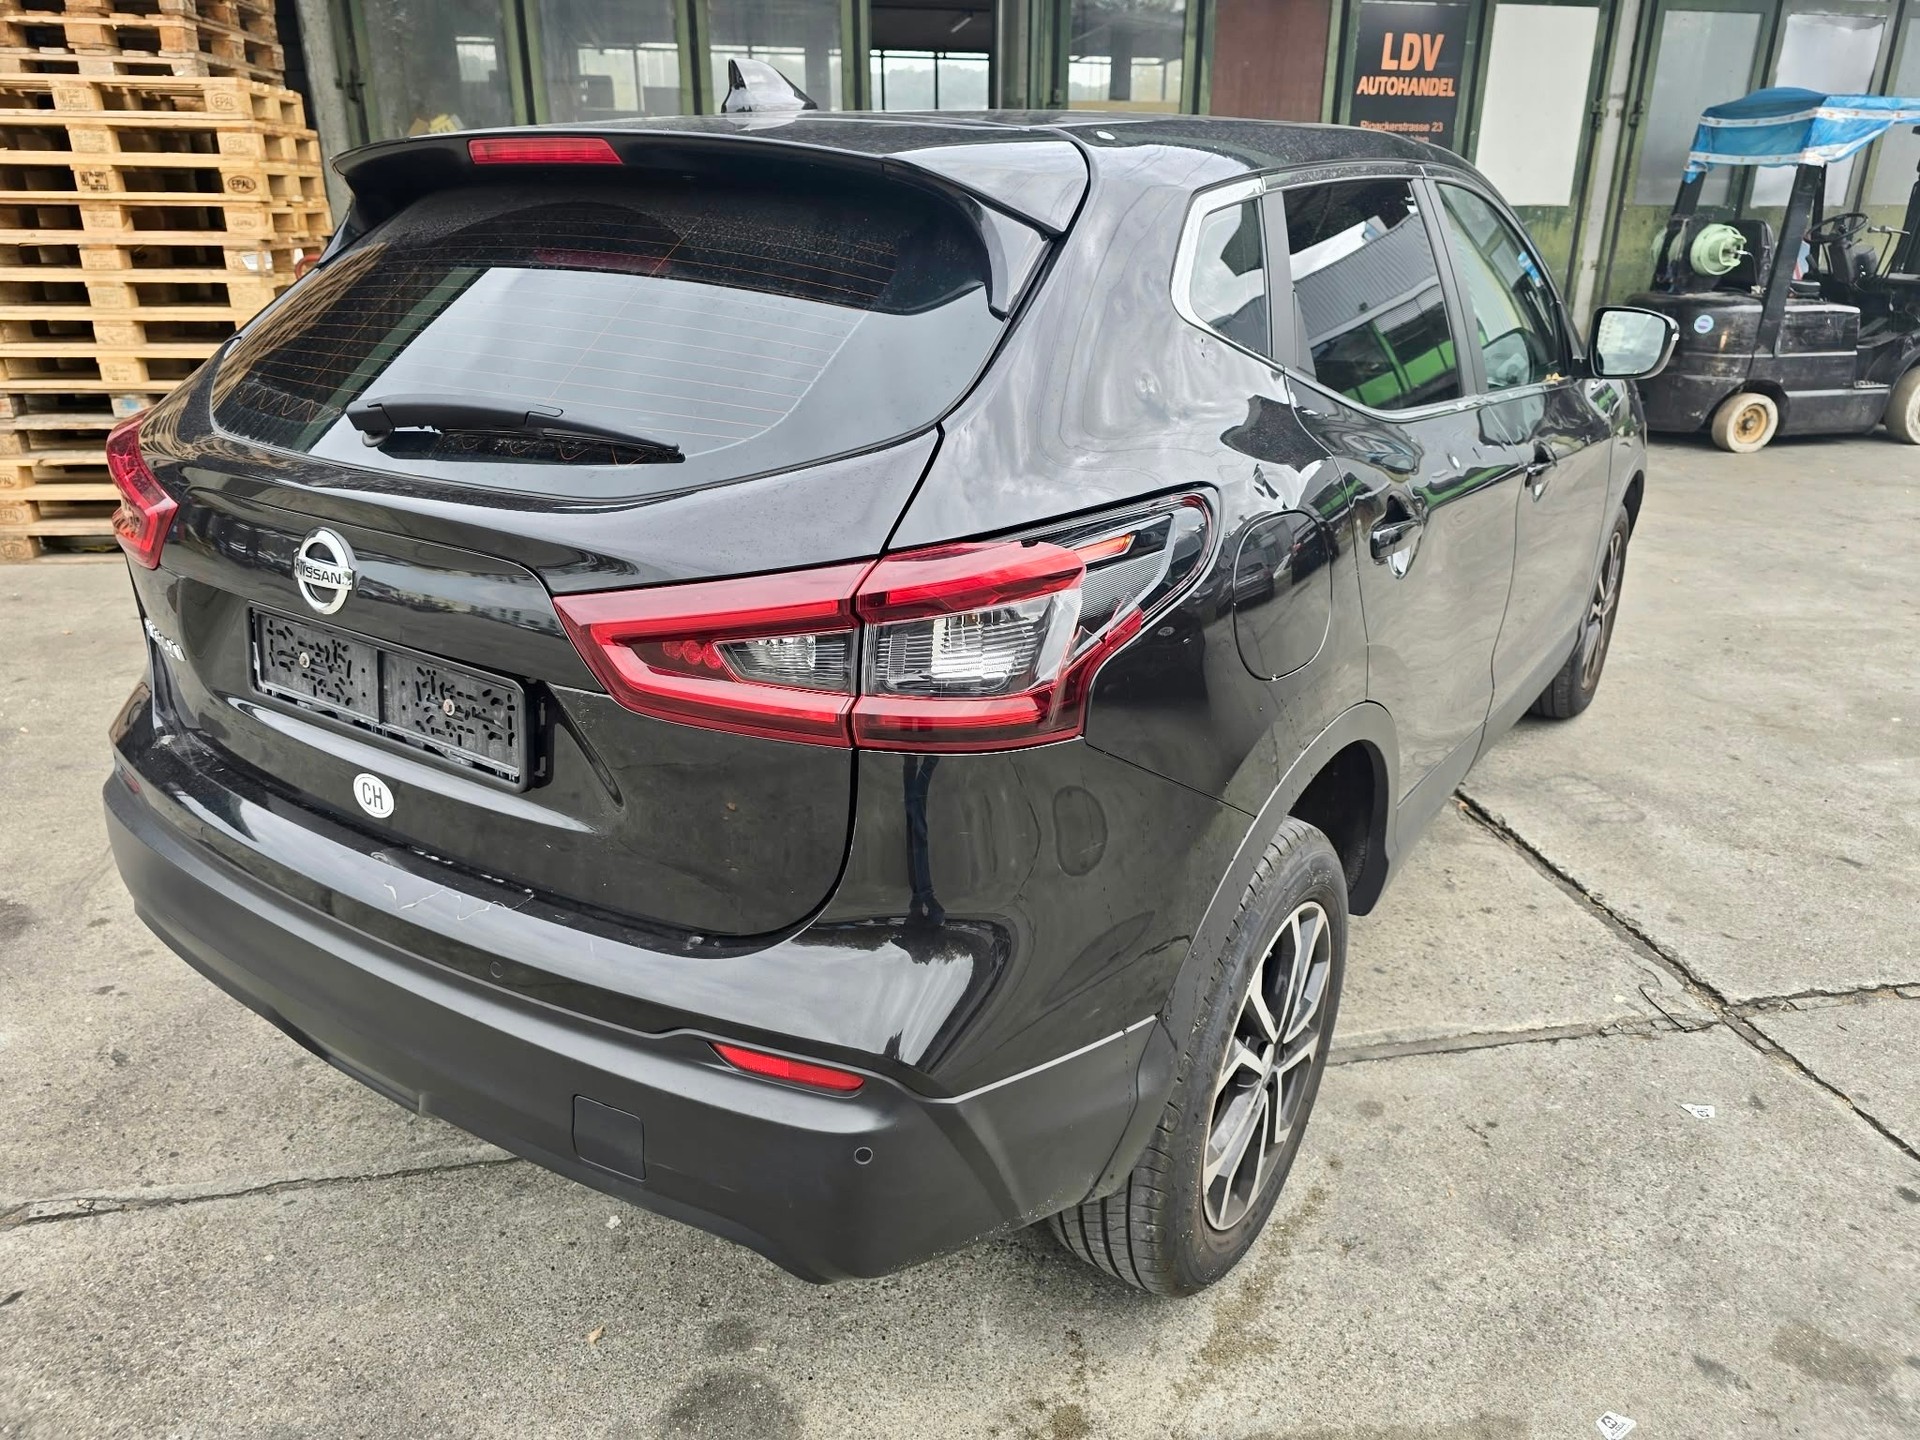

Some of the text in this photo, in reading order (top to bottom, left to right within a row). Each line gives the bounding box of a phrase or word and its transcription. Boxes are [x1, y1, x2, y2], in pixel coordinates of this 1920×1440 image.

[1381, 32, 1445, 71] LDV
[1356, 75, 1456, 97] AUTOHANDEL
[231, 178, 253, 190] EPAL
[295, 561, 342, 585] NISSAN
[362, 782, 384, 810] CH
